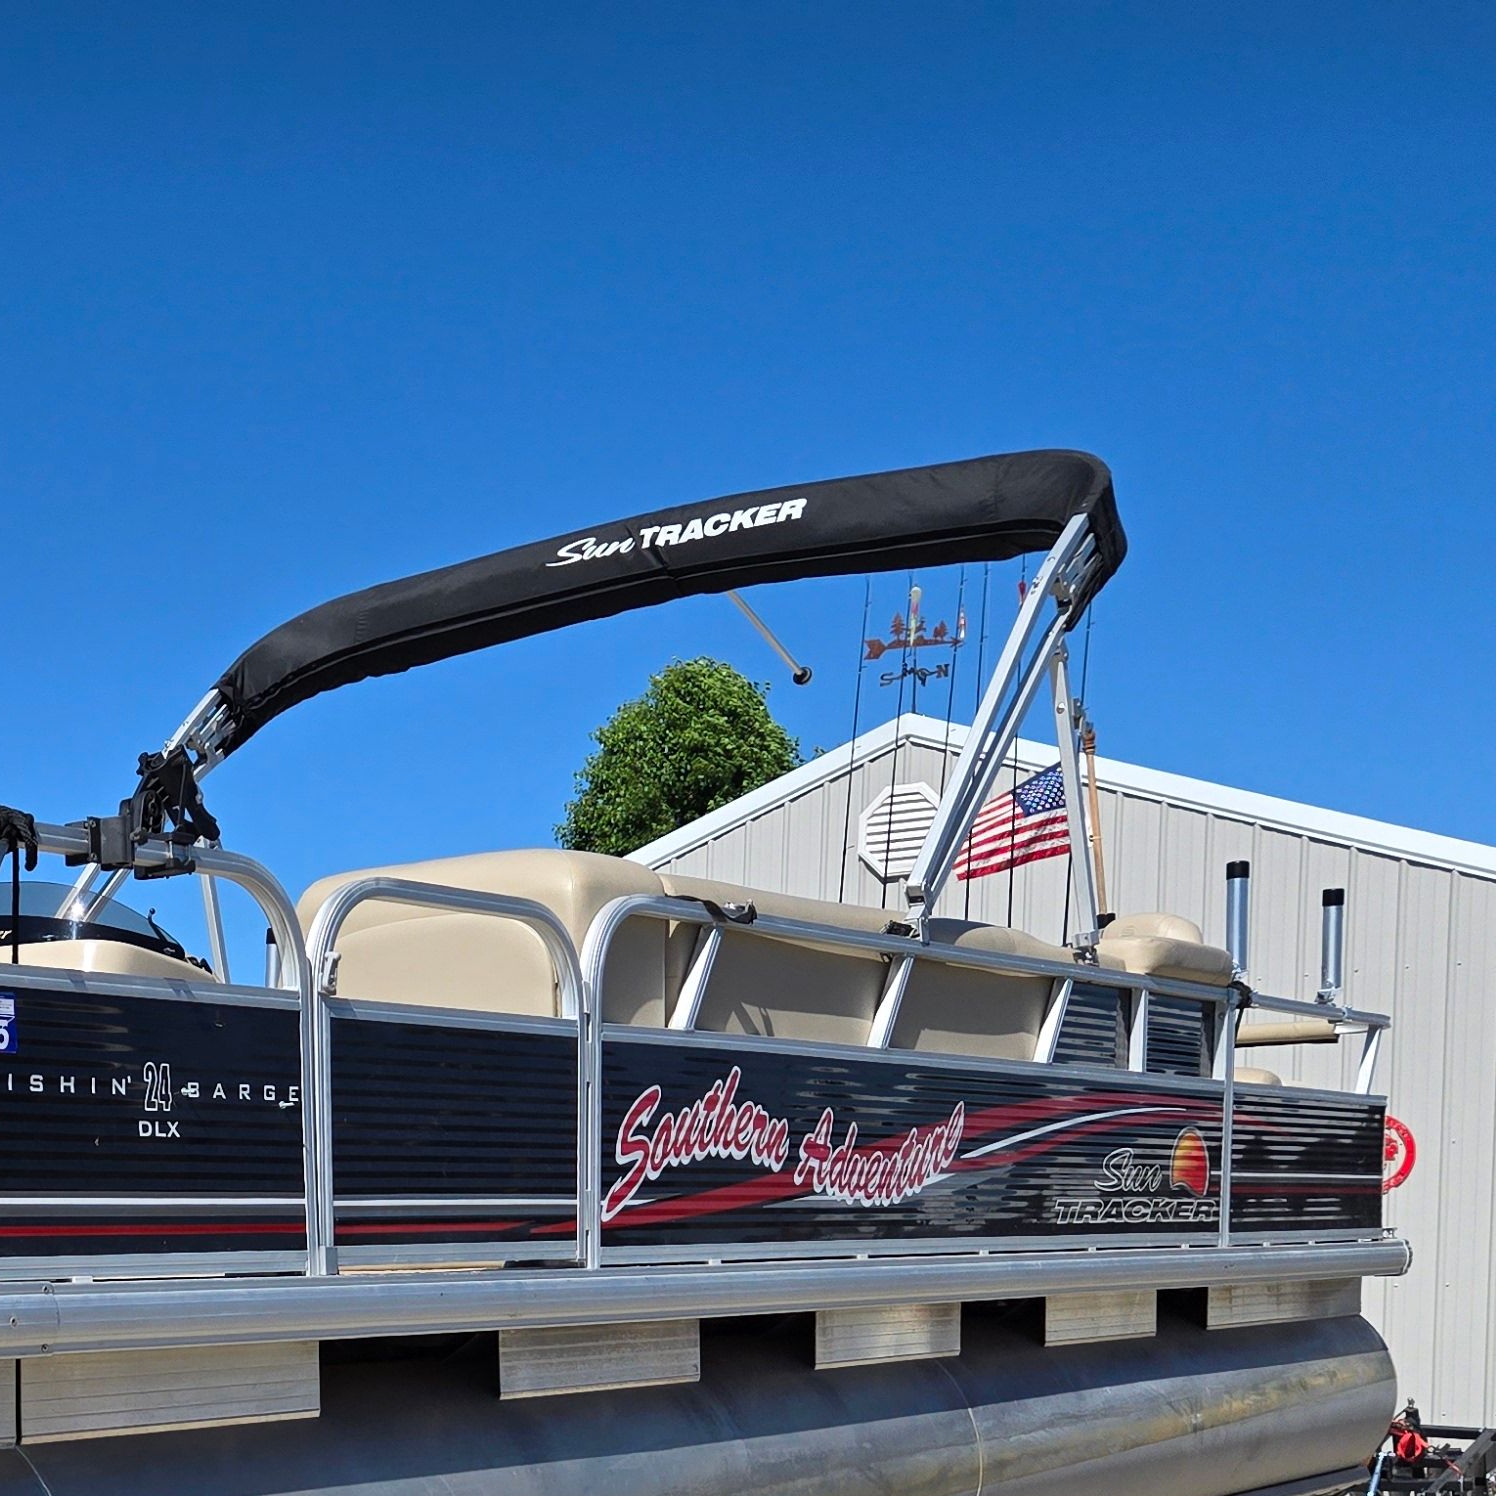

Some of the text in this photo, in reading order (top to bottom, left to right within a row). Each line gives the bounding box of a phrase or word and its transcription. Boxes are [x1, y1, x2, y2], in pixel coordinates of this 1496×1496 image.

[545, 498, 808, 567] Sun TRACKER
[143, 1062, 173, 1112] 24
[186, 1082, 300, 1103] BARGE
[138, 1120, 181, 1139] DLX
[601, 1065, 966, 1222] Southern Adventure
[1093, 1147, 1164, 1193] Sun
[1054, 1198, 1222, 1225] TRACKER
